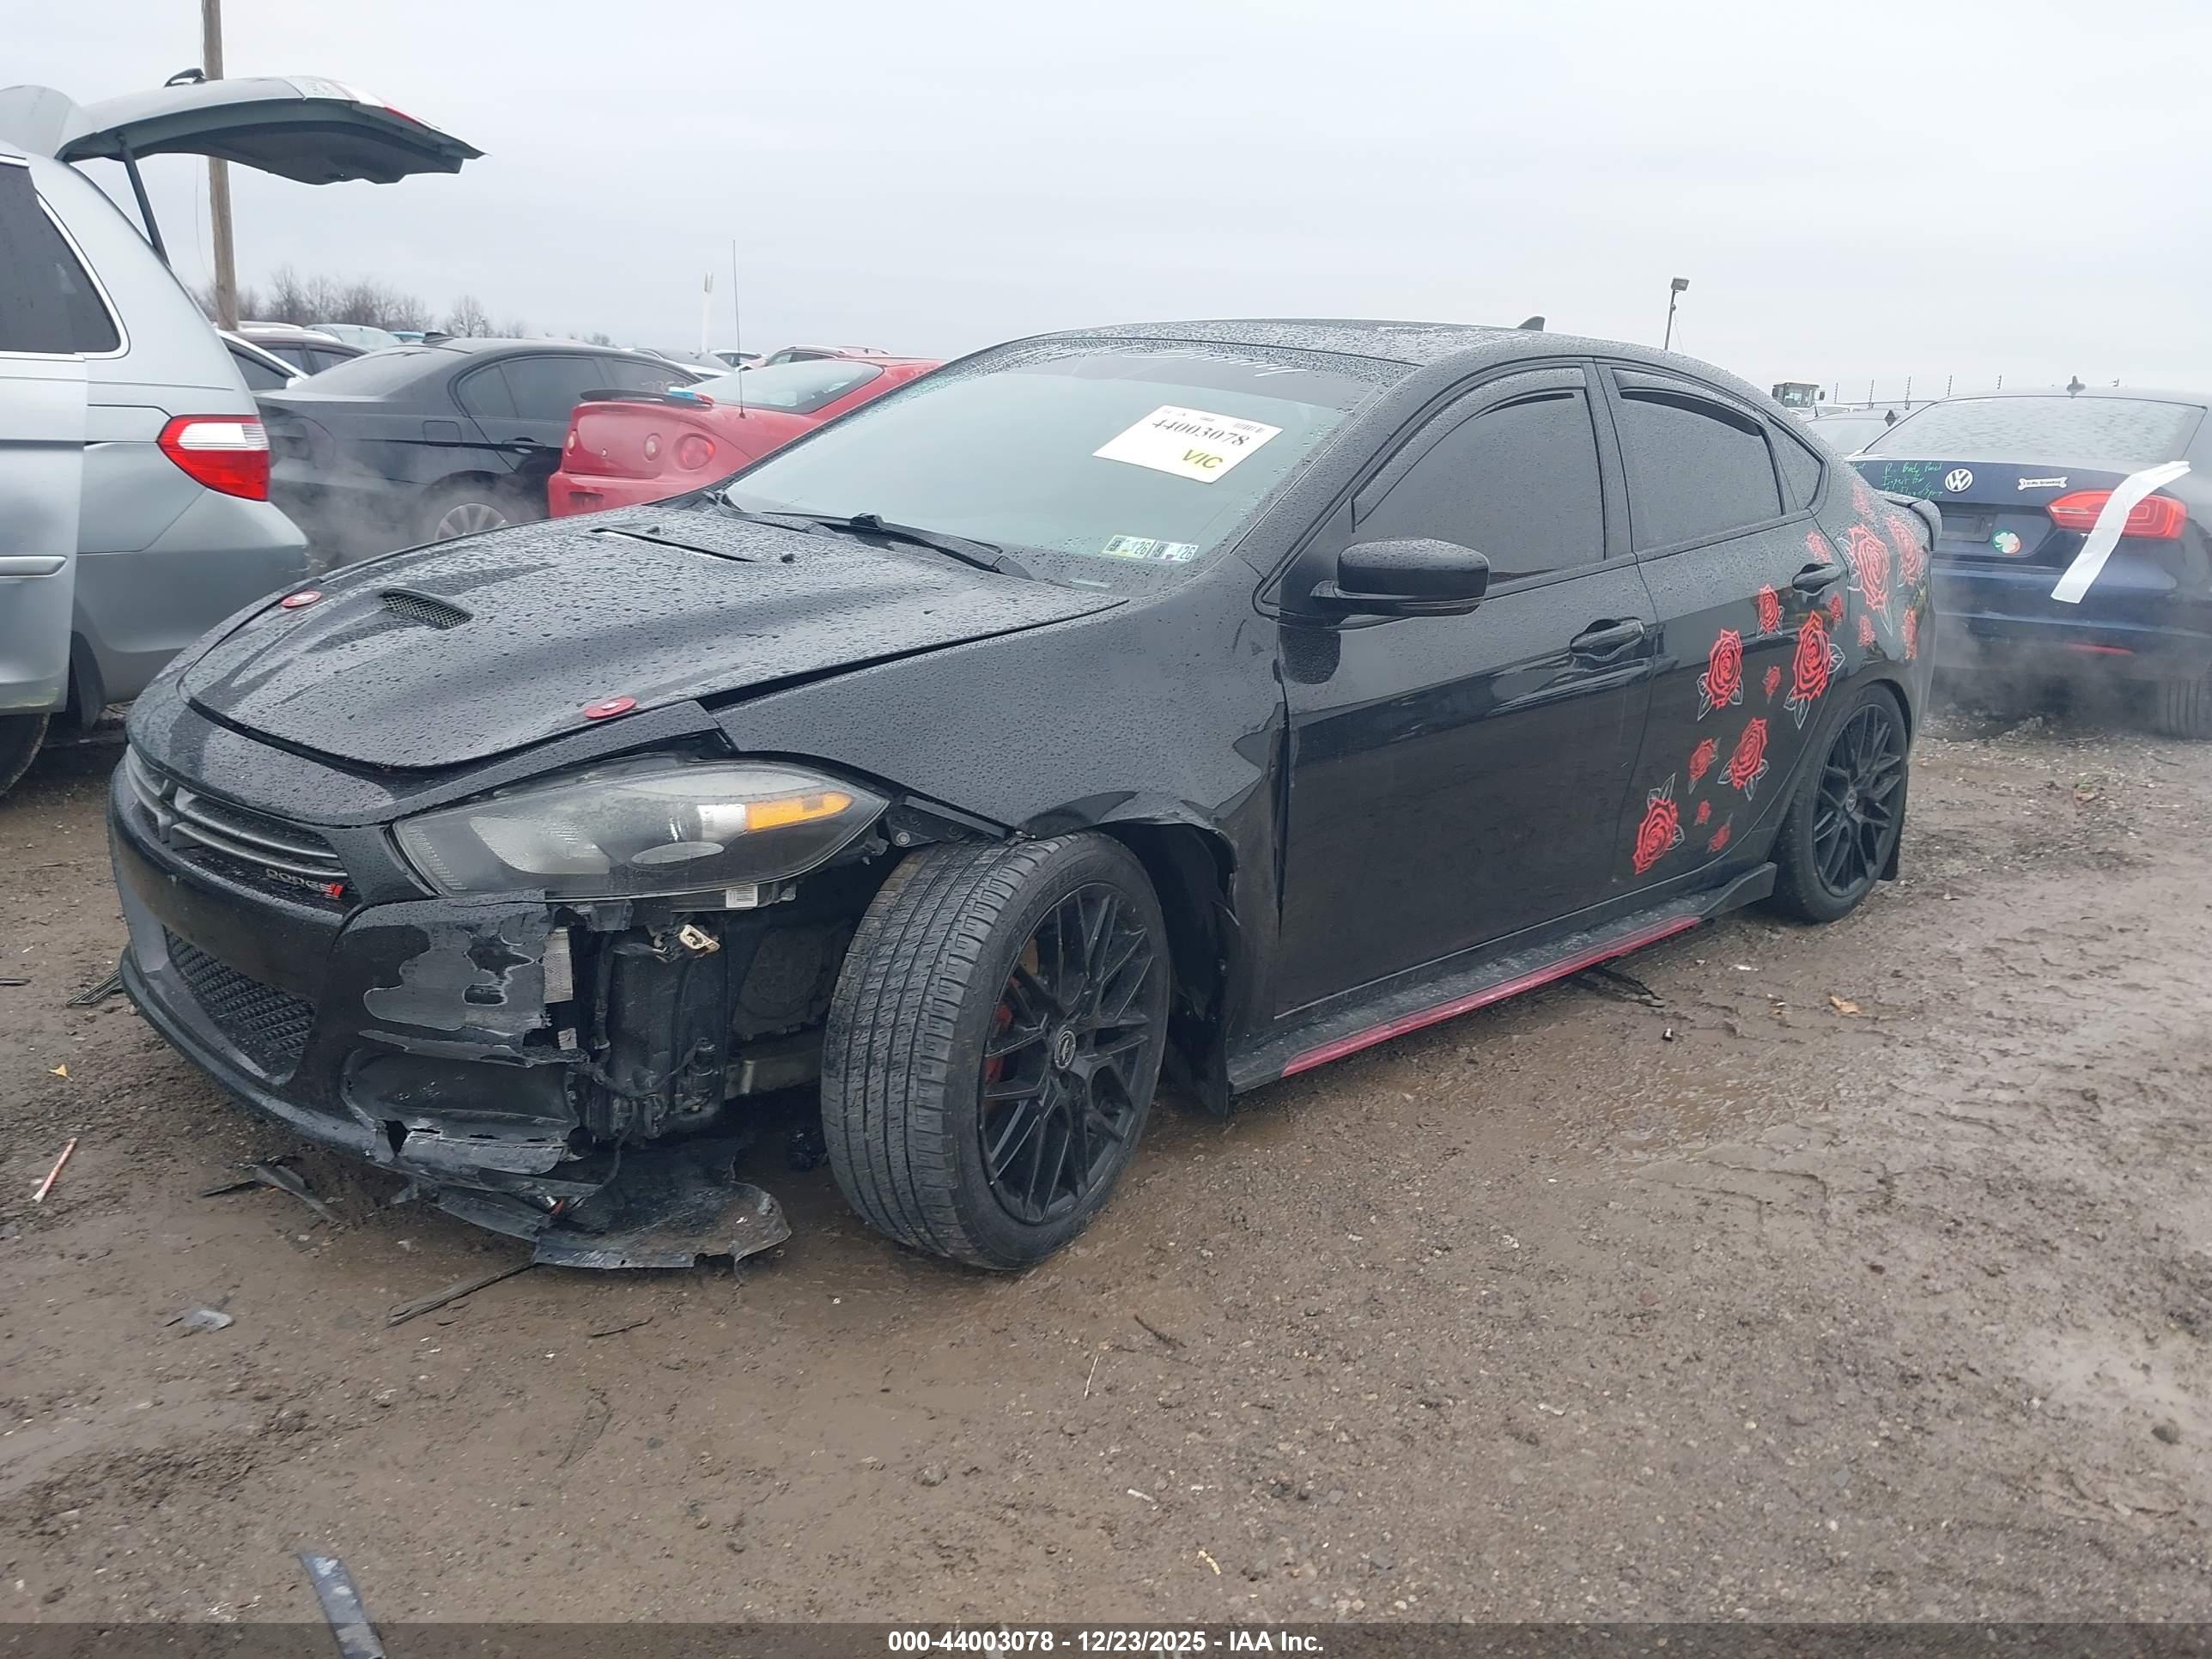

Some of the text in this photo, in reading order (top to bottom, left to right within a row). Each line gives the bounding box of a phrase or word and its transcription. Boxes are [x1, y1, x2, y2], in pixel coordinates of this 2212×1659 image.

[1152, 419, 1249, 446] 44003078
[1182, 449, 1224, 469] VIC
[265, 868, 333, 893] DODGE
